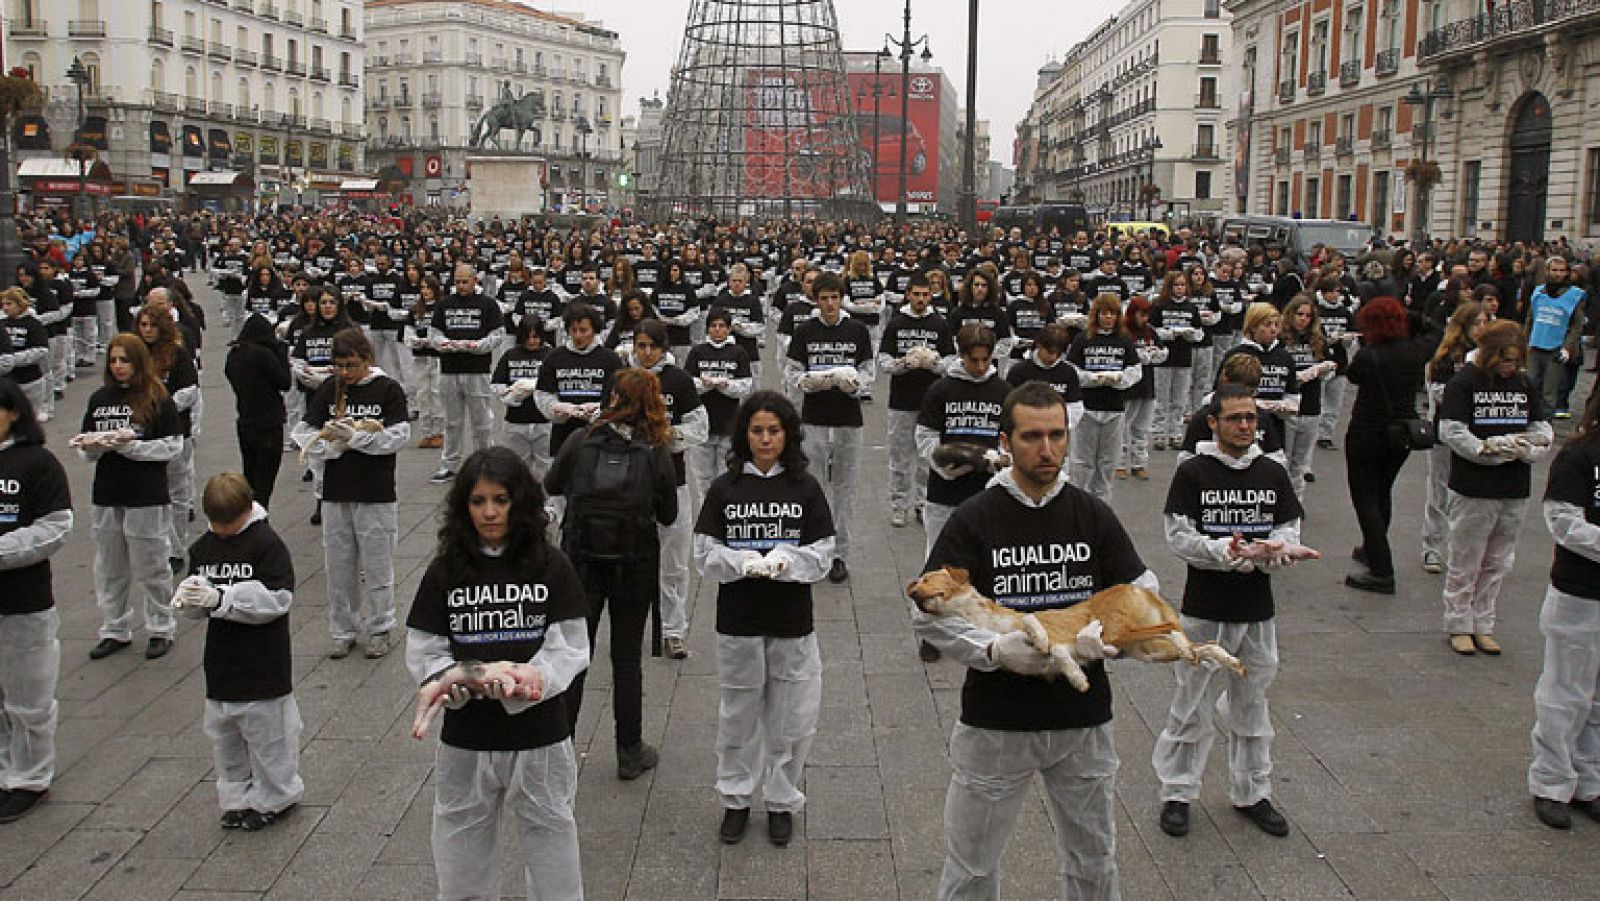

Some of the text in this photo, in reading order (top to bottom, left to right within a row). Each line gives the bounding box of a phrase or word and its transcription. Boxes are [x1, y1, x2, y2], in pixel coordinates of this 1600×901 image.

[1201, 489, 1276, 506] IGUALDAD
[991, 543, 1090, 568] IGUALDAD
[448, 583, 548, 608] IGUALDAD
